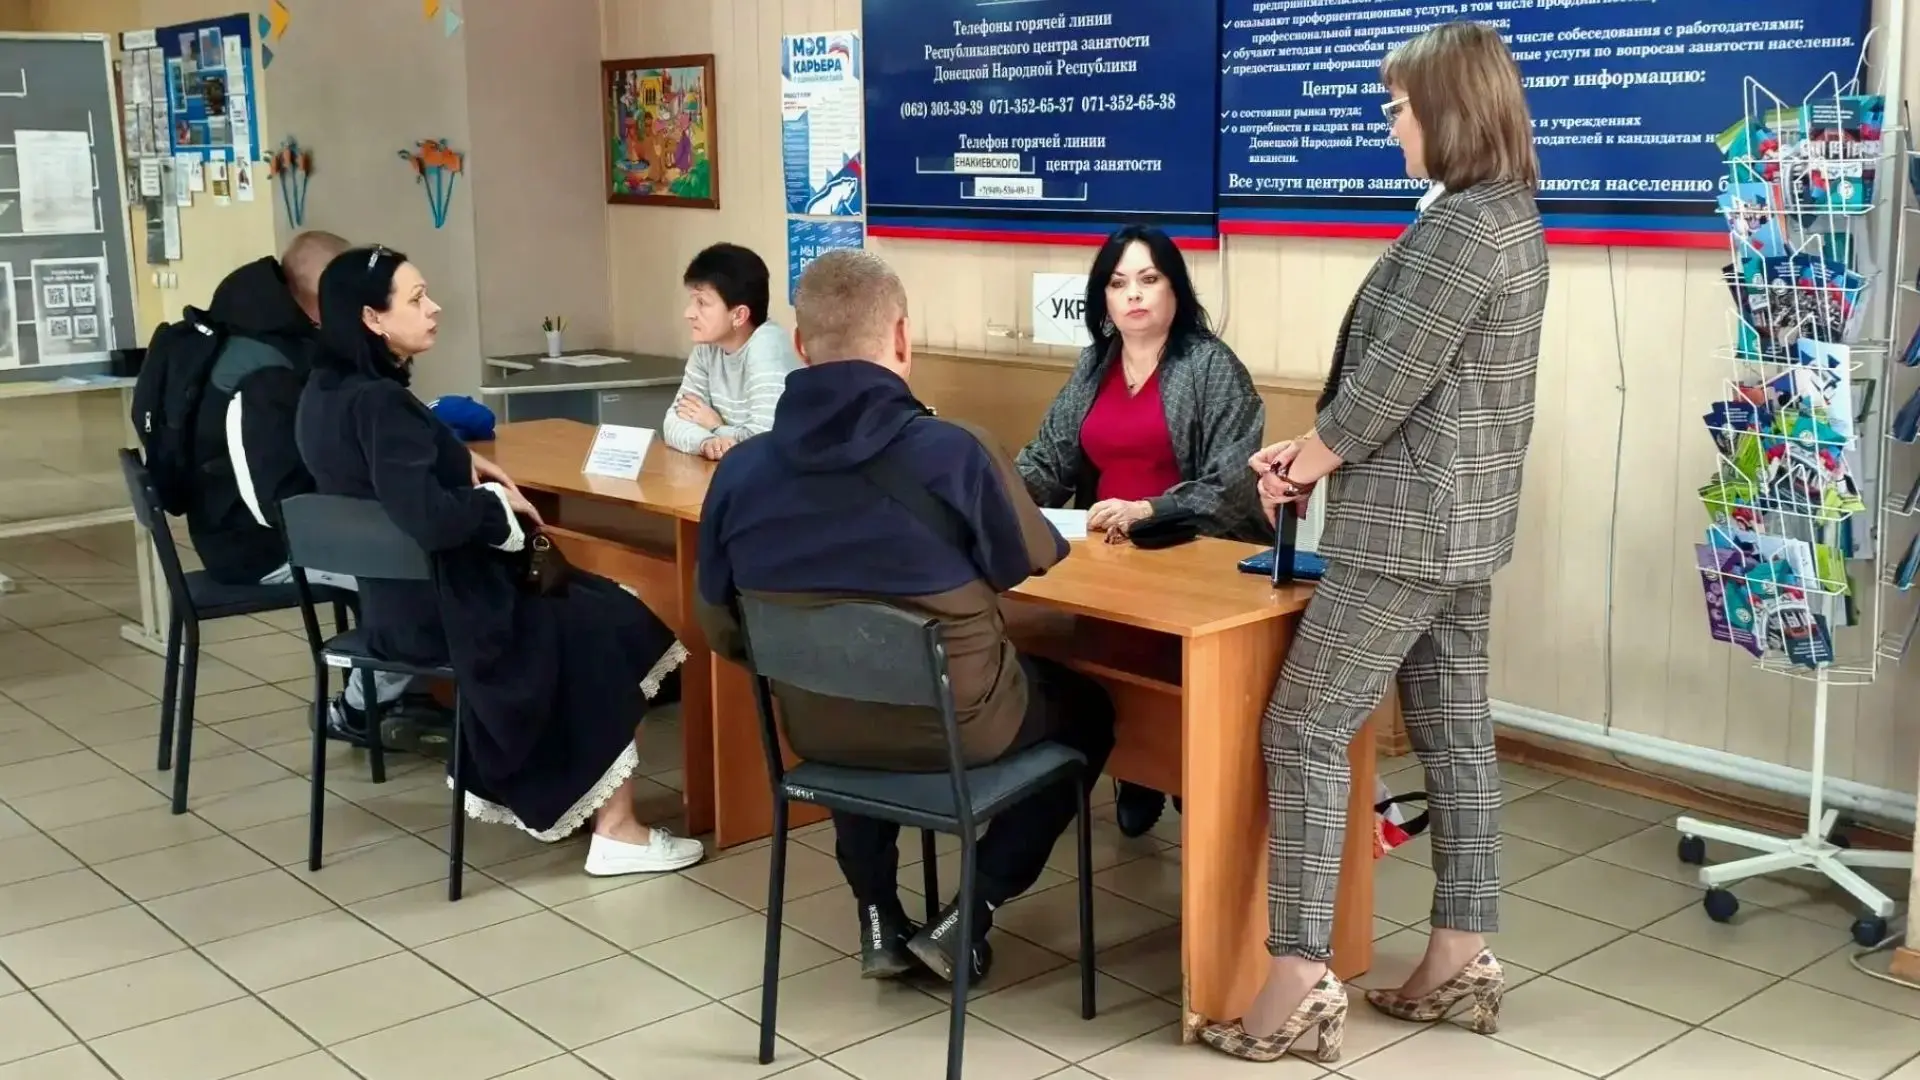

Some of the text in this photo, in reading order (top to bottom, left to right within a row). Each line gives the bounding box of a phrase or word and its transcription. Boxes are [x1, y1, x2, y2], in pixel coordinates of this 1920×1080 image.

[1234, 17, 1290, 28] оказывают
[1292, 8, 1412, 25] профориентационные
[1415, 5, 1458, 18] услуги,
[1461, 4, 1468, 12] в
[1470, 2, 1492, 11] том
[1496, 0, 1533, 9] числе
[954, 14, 1112, 37] Телефоны горячей линии
[1252, 26, 1351, 45] профессиональной
[925, 36, 1149, 61] Республиканского центра занятости
[1233, 47, 1276, 60] обучают
[1278, 46, 1322, 56] методам
[1334, 40, 1384, 52] способам
[1516, 32, 1554, 42] числе
[1558, 27, 1660, 40] собеседования
[1664, 26, 1672, 36] с
[1676, 20, 1803, 38] работодателями;
[793, 58, 842, 73] КАРЬЕРА
[1233, 63, 1310, 76] предоставляют
[1545, 48, 1590, 62] услуги
[1595, 48, 1611, 56] по
[1616, 44, 1684, 58] вопросам
[1688, 41, 1764, 52] занятости
[1768, 37, 1854, 50] населения.
[934, 57, 1136, 82] Донецкой Народной Республики
[1303, 81, 1357, 98] Центры
[1574, 69, 1705, 88] информацию:
[901, 93, 1175, 118] (062) 303-39-39 071-352-65-37 071-352-65-38
[1240, 109, 1291, 118] состоянии
[1294, 108, 1326, 119] рынка
[1329, 107, 1362, 118] труда;
[1304, 124, 1310, 132] в
[1313, 124, 1349, 134] кадрах
[1551, 117, 1641, 129] учреждениях
[959, 134, 1105, 152] Телефон горячей линии
[1249, 137, 1298, 149] Донецкой
[1302, 136, 1352, 149] Народной
[1606, 136, 1614, 144] к
[1618, 134, 1702, 144] кандидатам
[955, 158, 1161, 174] ЕНАКИЕВСКОГО центра занятости
[1229, 174, 1252, 188] Все
[1256, 178, 1302, 191] услуги
[1306, 178, 1364, 192] центров
[1606, 179, 1713, 192] населению
